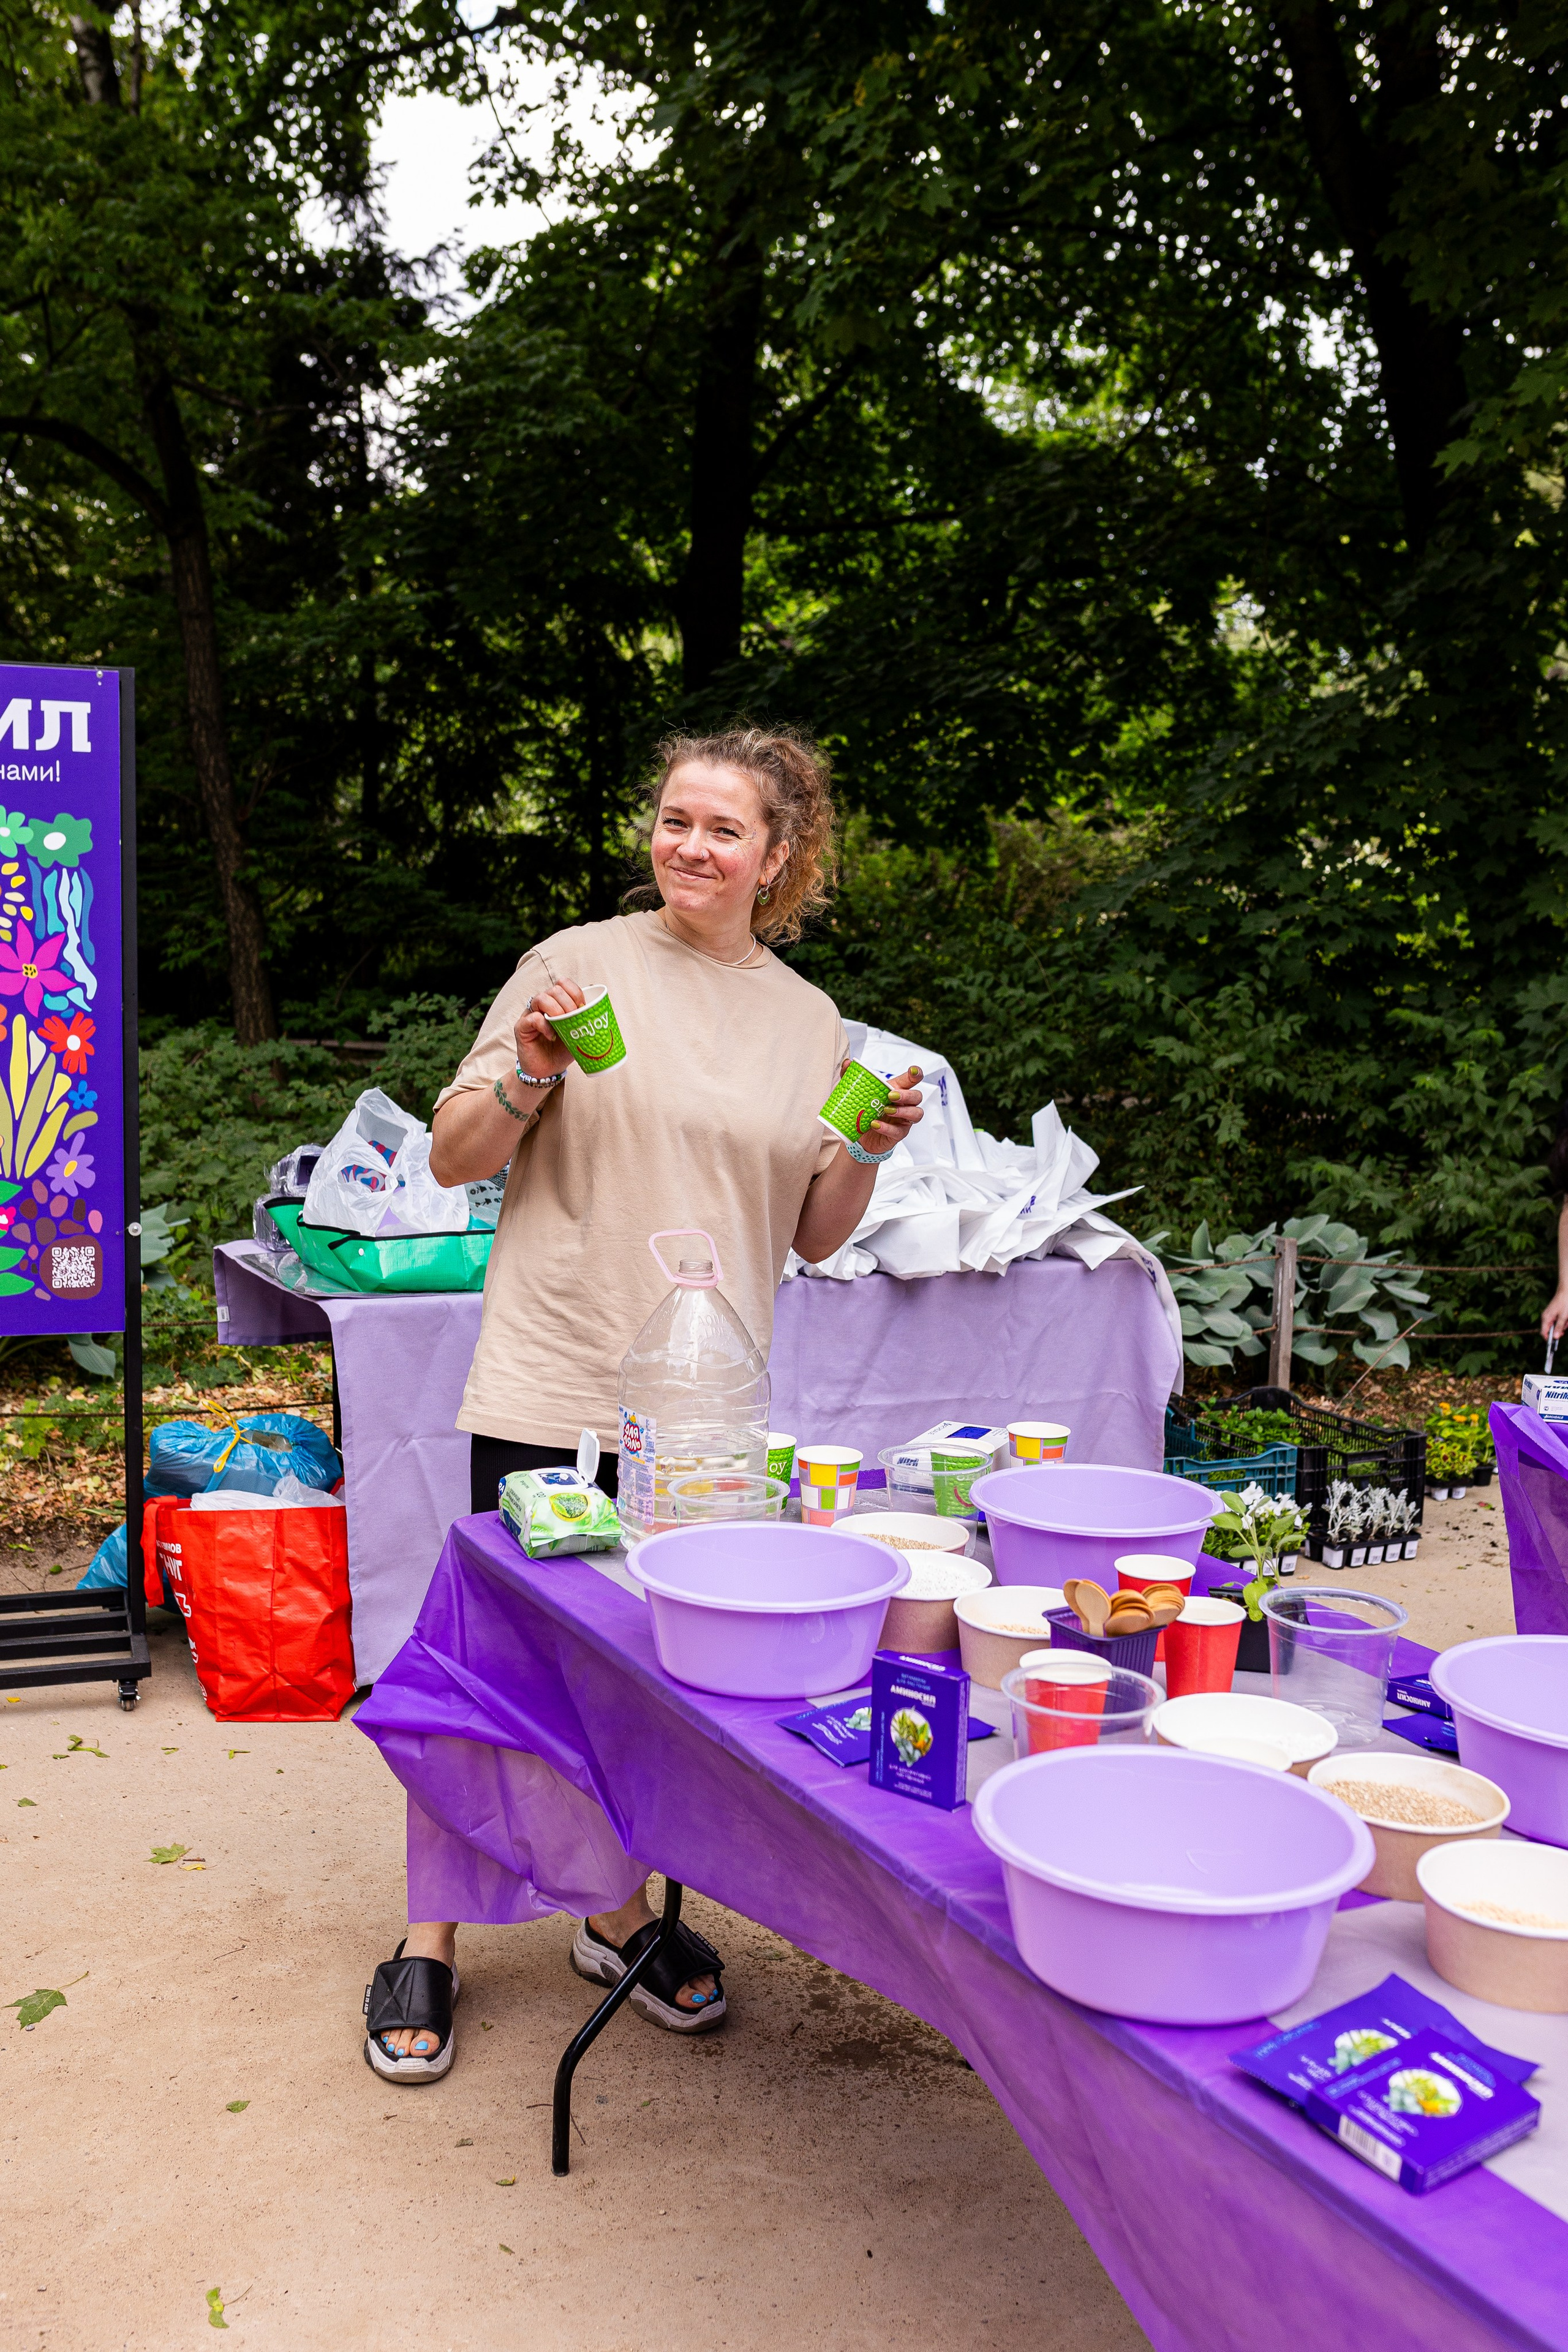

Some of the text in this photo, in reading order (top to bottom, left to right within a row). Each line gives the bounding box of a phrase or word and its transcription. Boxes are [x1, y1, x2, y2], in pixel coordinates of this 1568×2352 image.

[570, 1011, 608, 1039] enjoy
[890, 1684, 937, 1703] АМИНОСИЛ
[1397, 1692, 1431, 1708] АМИНОСИЛ
